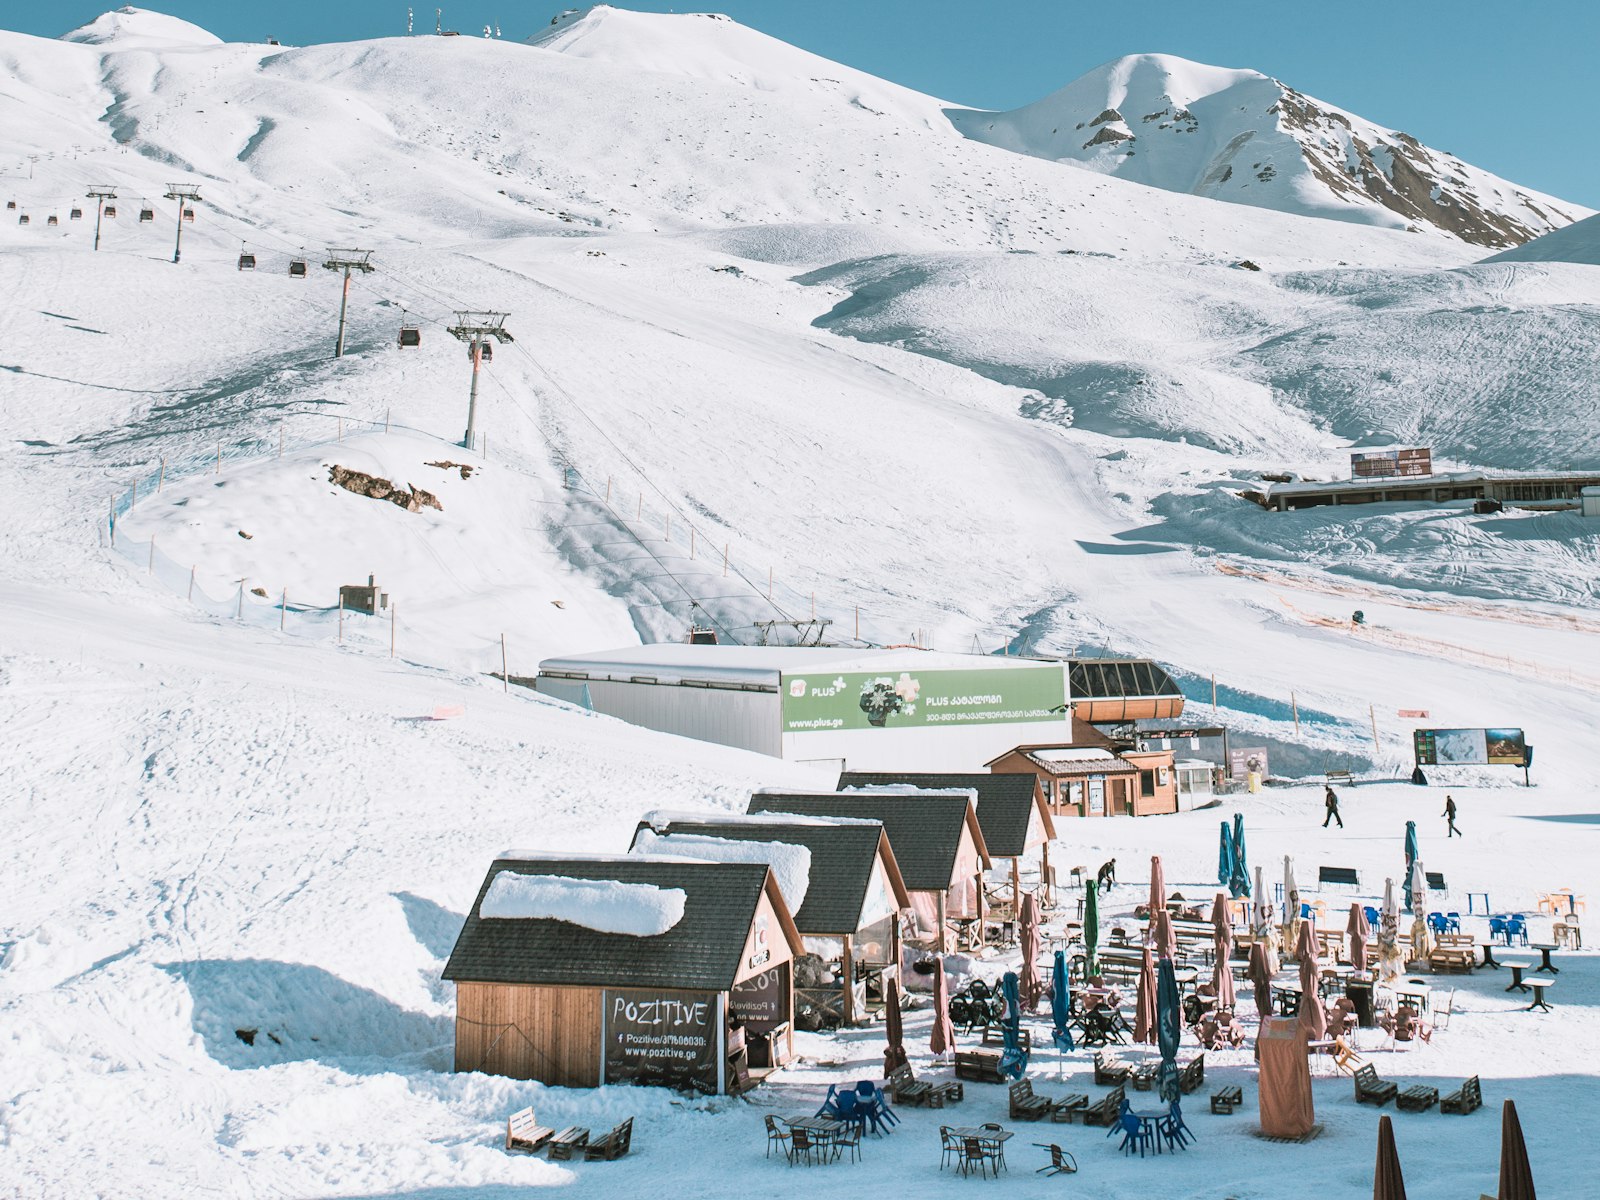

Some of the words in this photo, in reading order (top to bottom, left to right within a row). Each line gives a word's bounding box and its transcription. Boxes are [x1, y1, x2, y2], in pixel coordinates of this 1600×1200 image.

[811, 687, 835, 697] PLUS
[926, 697, 949, 706] PLUS
[789, 717, 843, 729] www.plus.ge
[613, 997, 708, 1026] POZITIVE
[625, 1047, 697, 1060] www.pozitive.ge
